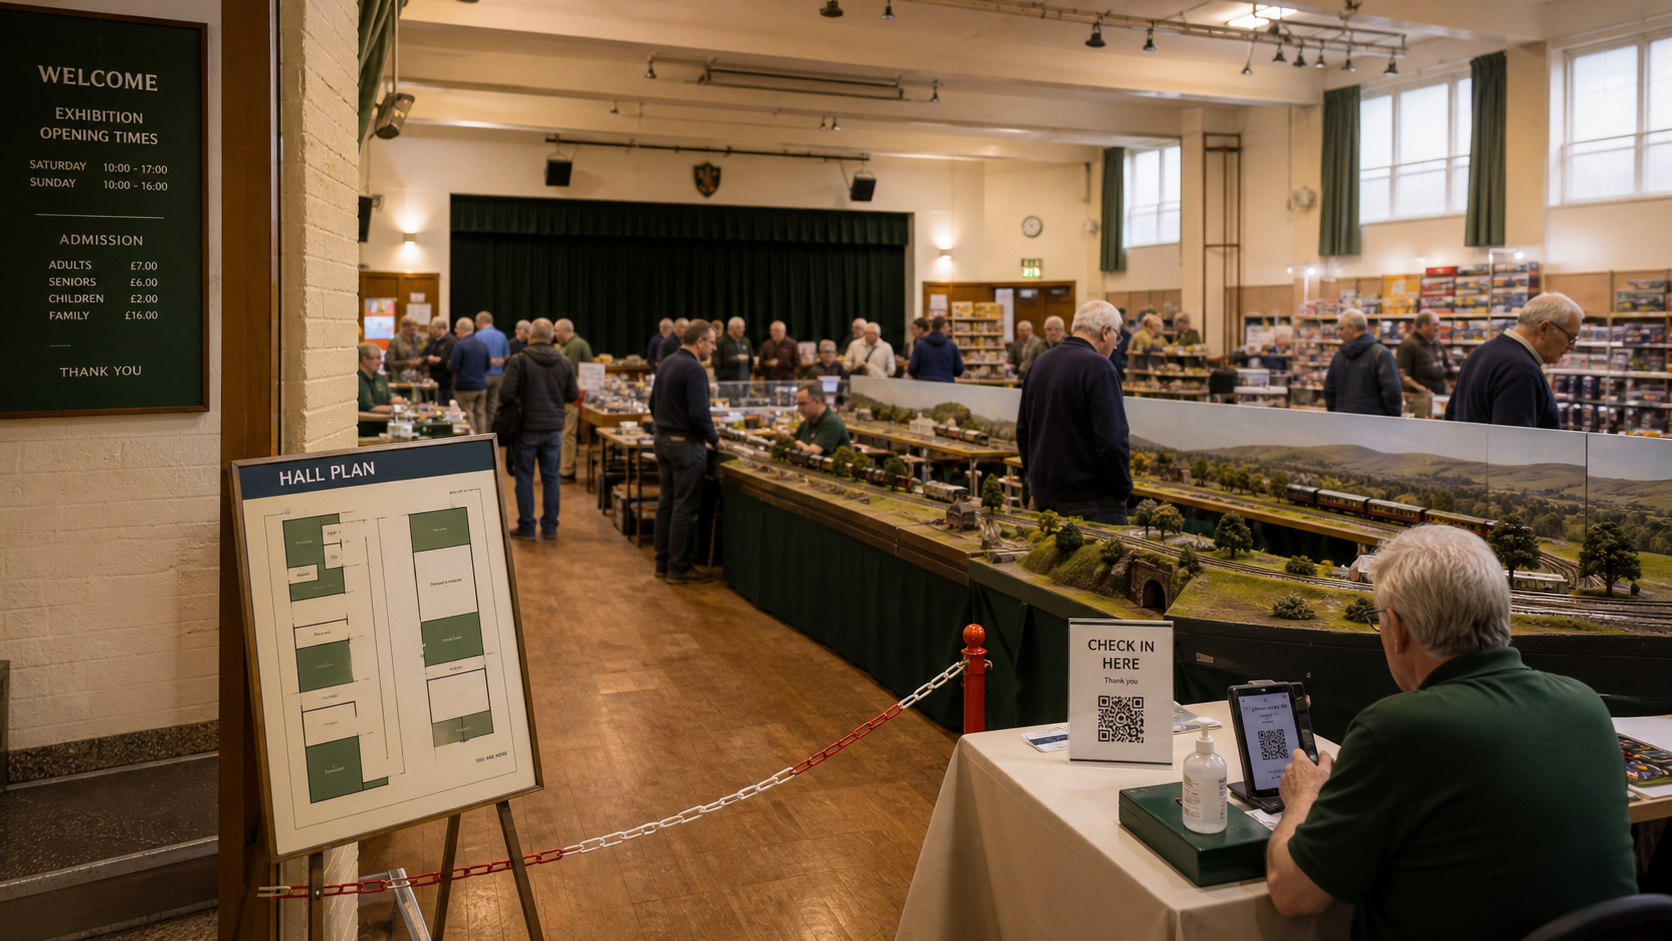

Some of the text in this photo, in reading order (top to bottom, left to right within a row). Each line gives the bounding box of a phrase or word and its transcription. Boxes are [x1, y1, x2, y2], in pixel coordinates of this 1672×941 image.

[38, 64, 158, 92] WELCOME
[55, 107, 144, 124] EXHIBITION
[40, 126, 158, 145] OPENING TIMES
[30, 160, 87, 171] SATURDAY
[103, 162, 130, 173] 10:00
[141, 164, 168, 174] 17:00
[30, 177, 76, 188] SUNDAY
[103, 180, 130, 190] 10:00
[141, 181, 168, 191] 16:00
[60, 234, 143, 246] ADMISSION
[48, 260, 158, 270] ADULTS £7.00
[48, 277, 158, 287] SENIORS £6.00
[48, 294, 158, 303] CHILDREN £2.00
[49, 311, 158, 320] FAMILY £16.00
[60, 365, 142, 378] THANK YOU
[280, 461, 375, 486] HALL PLAN
[1088, 639, 1154, 652] CHECK IN
[1103, 657, 1140, 670] HERE
